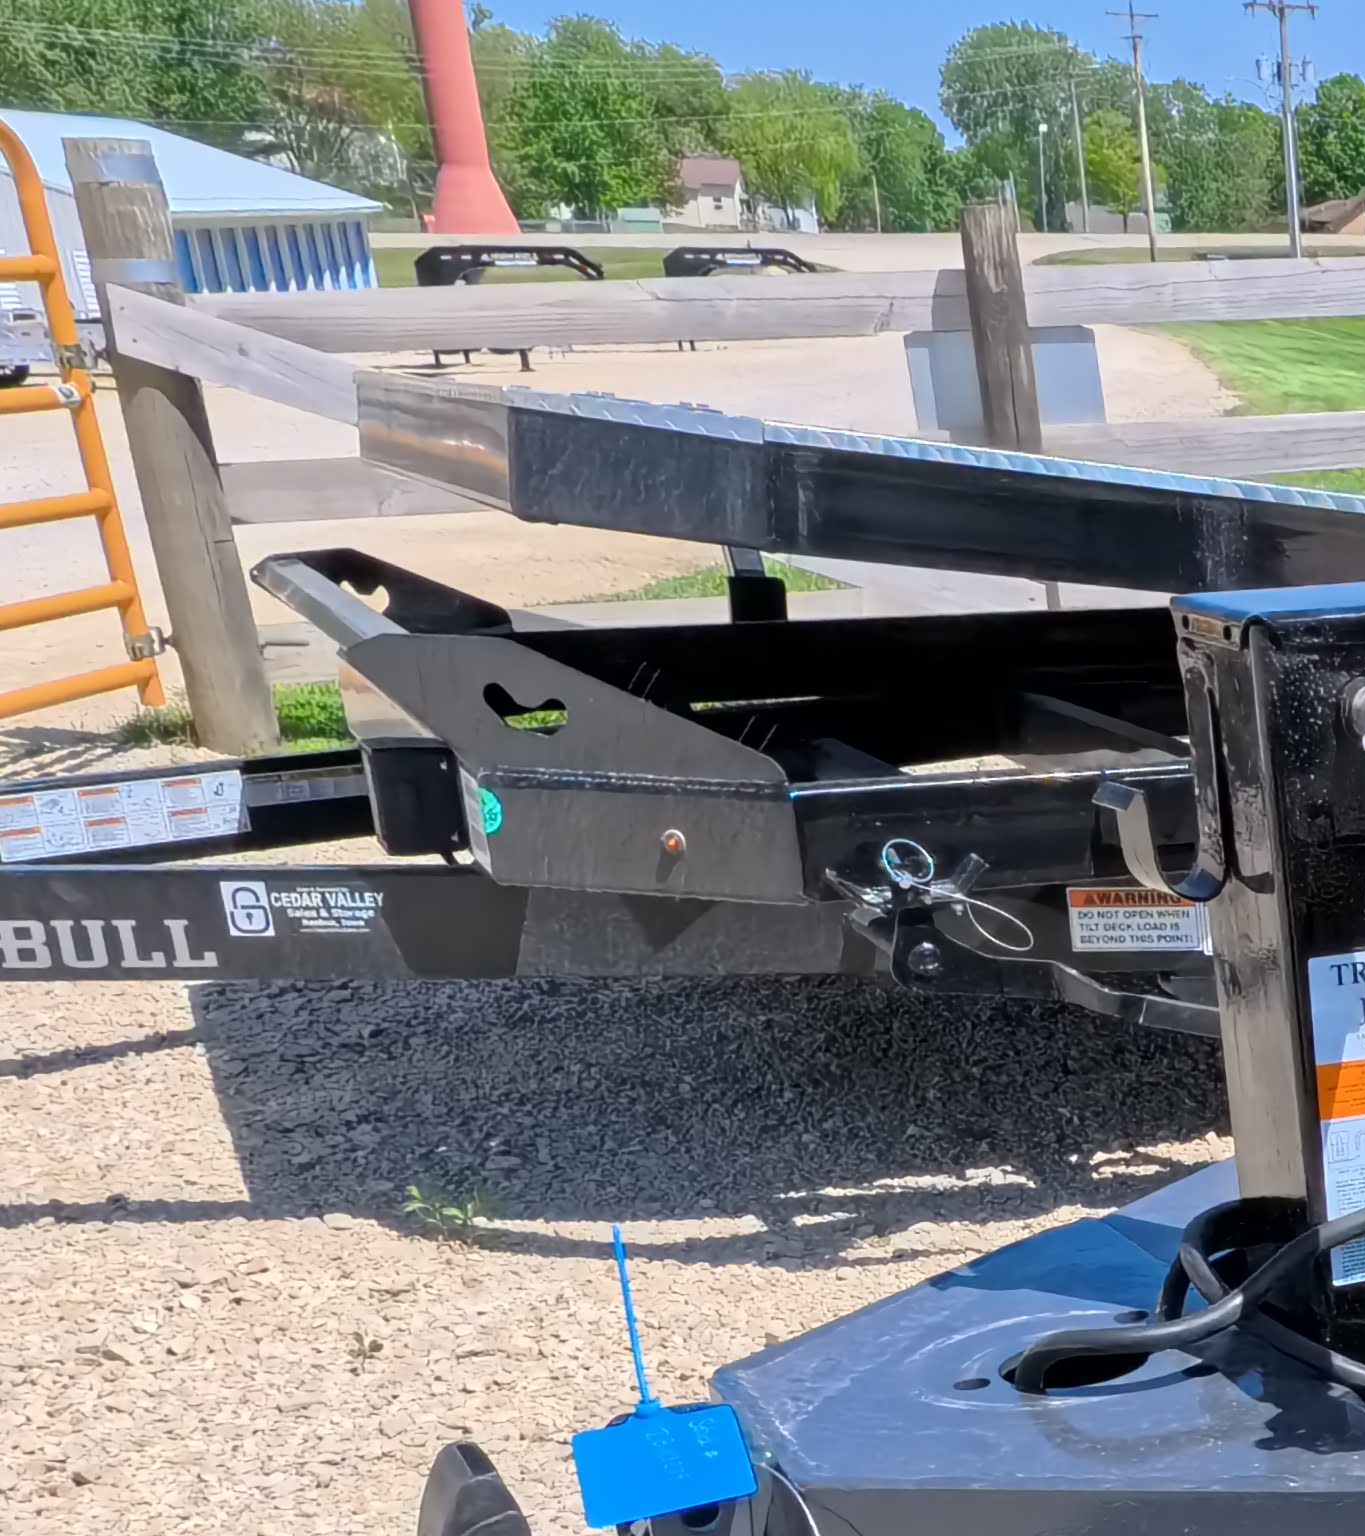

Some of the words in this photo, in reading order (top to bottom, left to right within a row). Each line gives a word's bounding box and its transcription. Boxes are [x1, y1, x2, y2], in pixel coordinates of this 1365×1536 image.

[270, 892, 323, 907] CEDAR
[325, 892, 384, 907] VALLEY
[1096, 891, 1182, 905] WARNING
[0, 919, 219, 968] BULL
